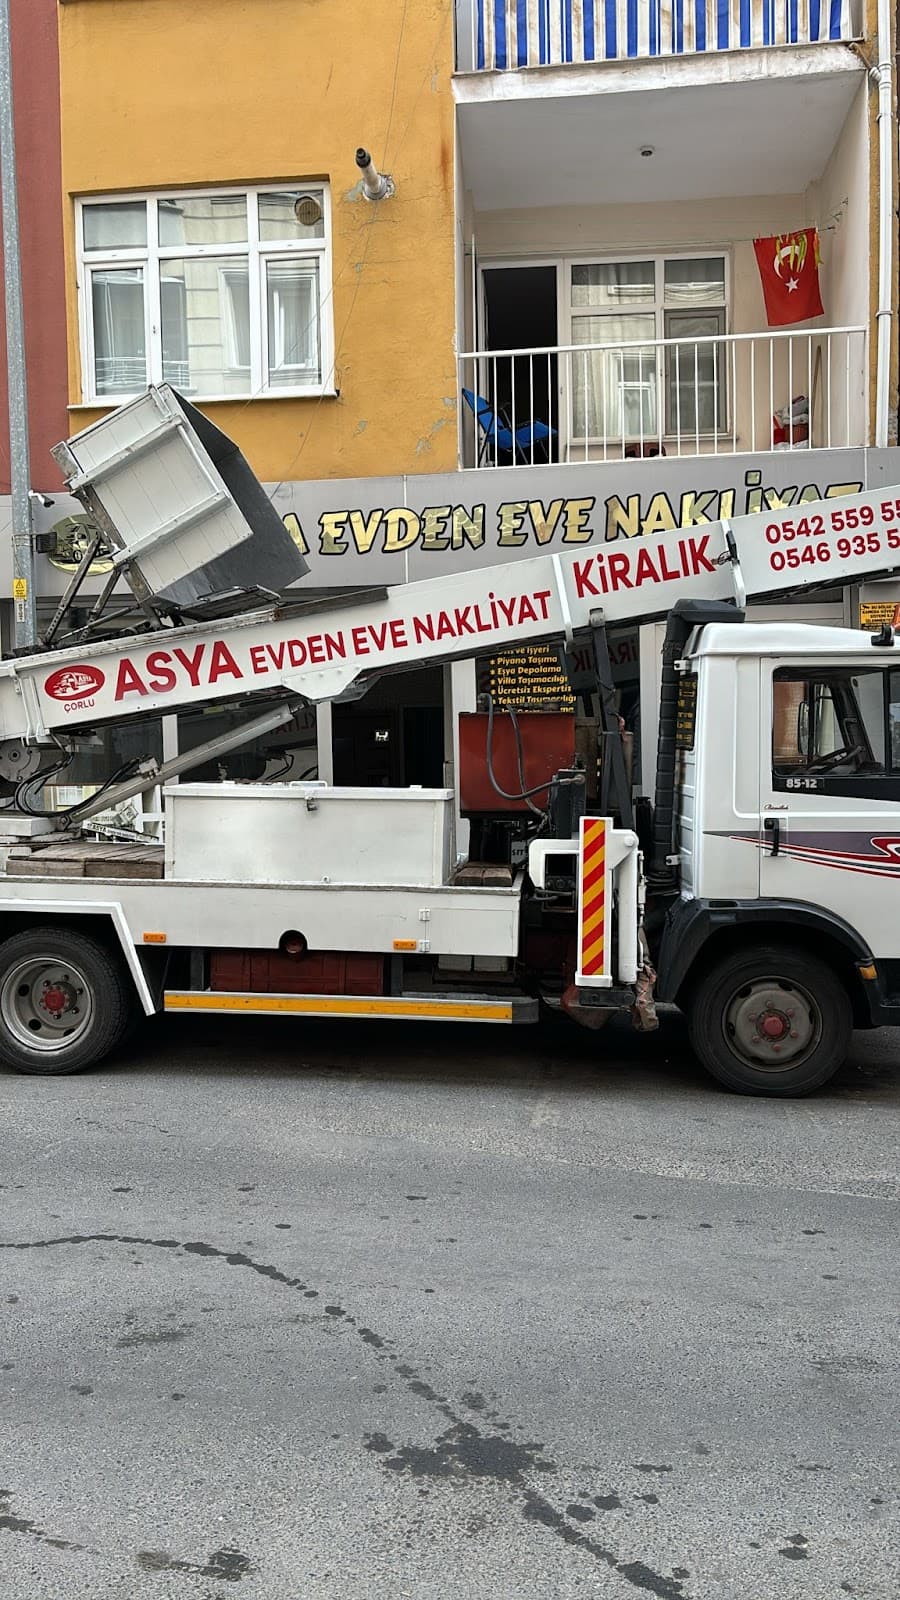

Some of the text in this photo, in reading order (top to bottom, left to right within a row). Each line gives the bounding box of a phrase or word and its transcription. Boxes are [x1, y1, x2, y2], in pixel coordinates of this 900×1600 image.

[318, 503, 486, 555] EVDEN
[497, 496, 596, 546] EVE
[604, 470, 864, 542] NAKLİY
[765, 515, 826, 544] 0542
[831, 506, 874, 532] 559
[770, 542, 831, 571] 0546
[837, 532, 881, 558] 935
[115, 590, 551, 701] ASYA EVDEN EVE NAKLİYAT
[497, 656, 558, 666] Piyano Taşıma
[518, 665, 561, 674] Depolama
[497, 676, 516, 685] Villa
[498, 684, 572, 695] Ücretsiz Ekspertiz
[64, 699, 95, 713] ÇORLU
[498, 696, 526, 705] Tekstil
[786, 778, 817, 789] 85-12
